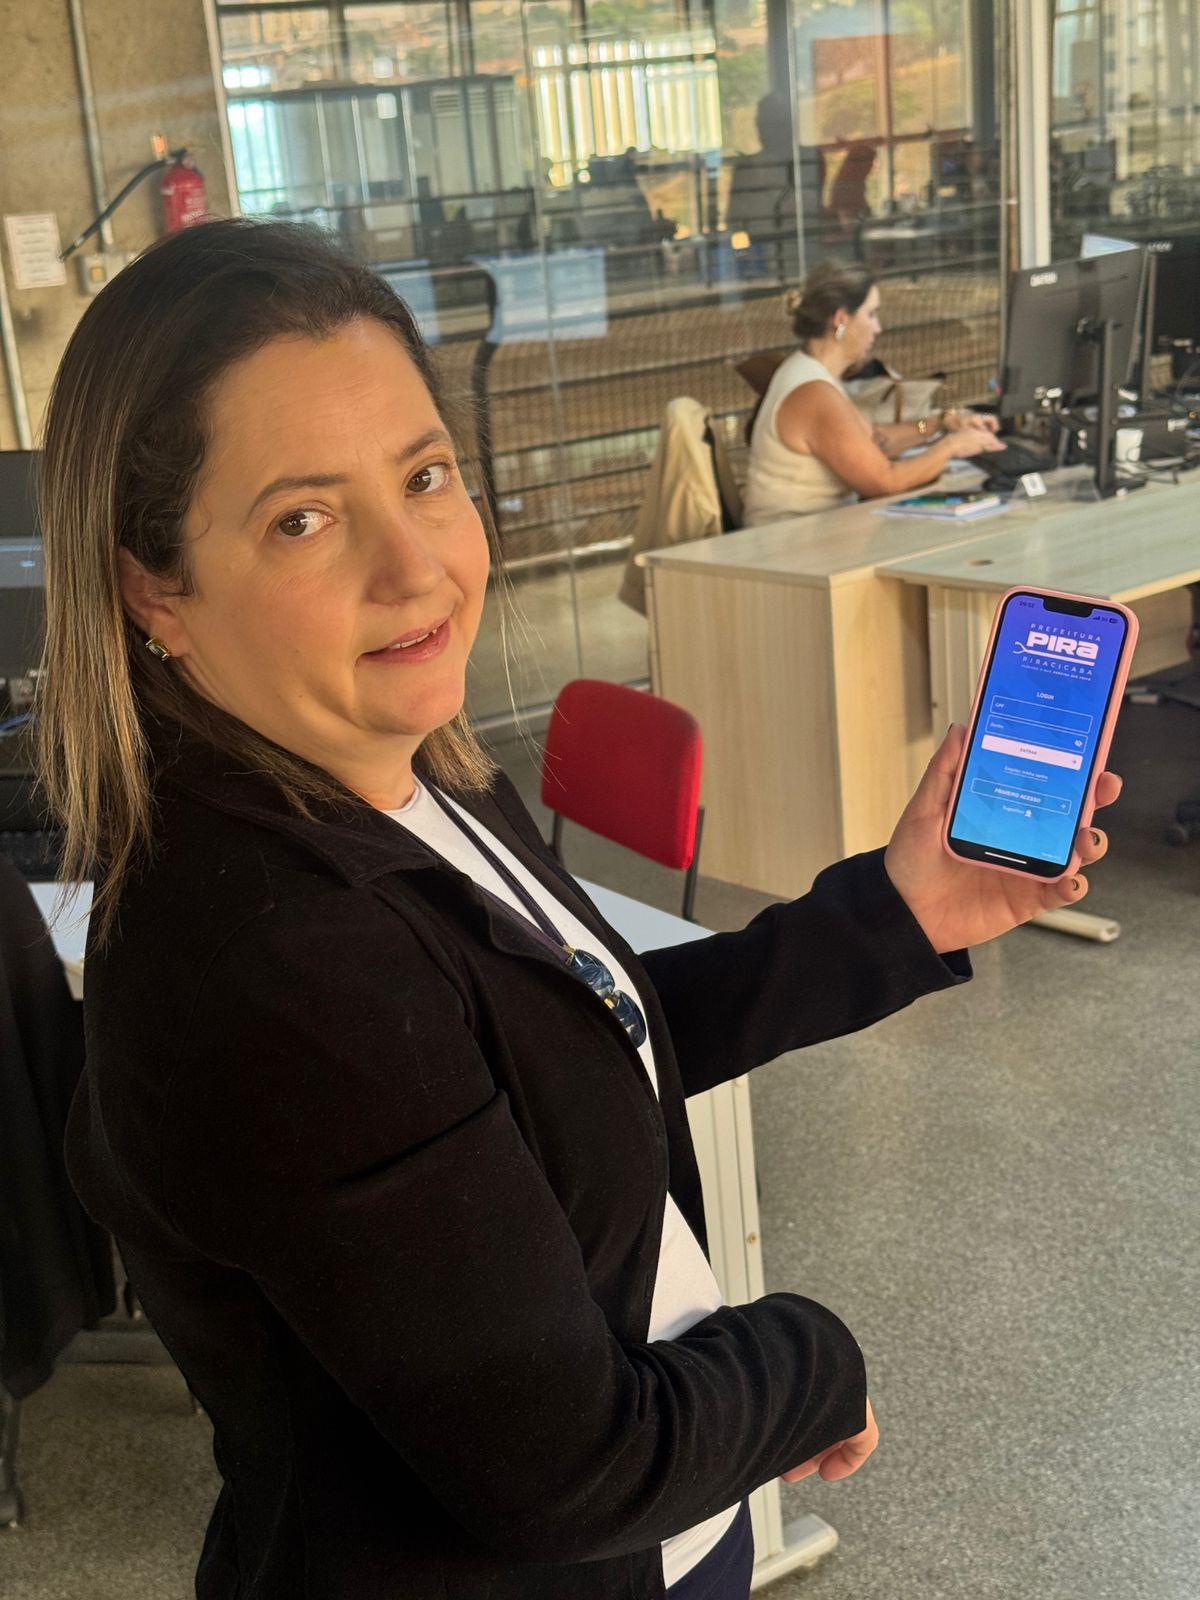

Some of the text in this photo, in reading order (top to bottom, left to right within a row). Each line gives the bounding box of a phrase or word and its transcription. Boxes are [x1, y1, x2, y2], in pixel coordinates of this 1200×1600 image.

[1030, 623, 1101, 642] PREFEITURA
[1022, 656, 1093, 675] PIRACICABA
[1036, 692, 1054, 700] LOGIN
[1020, 794, 1041, 803] ACESSO
